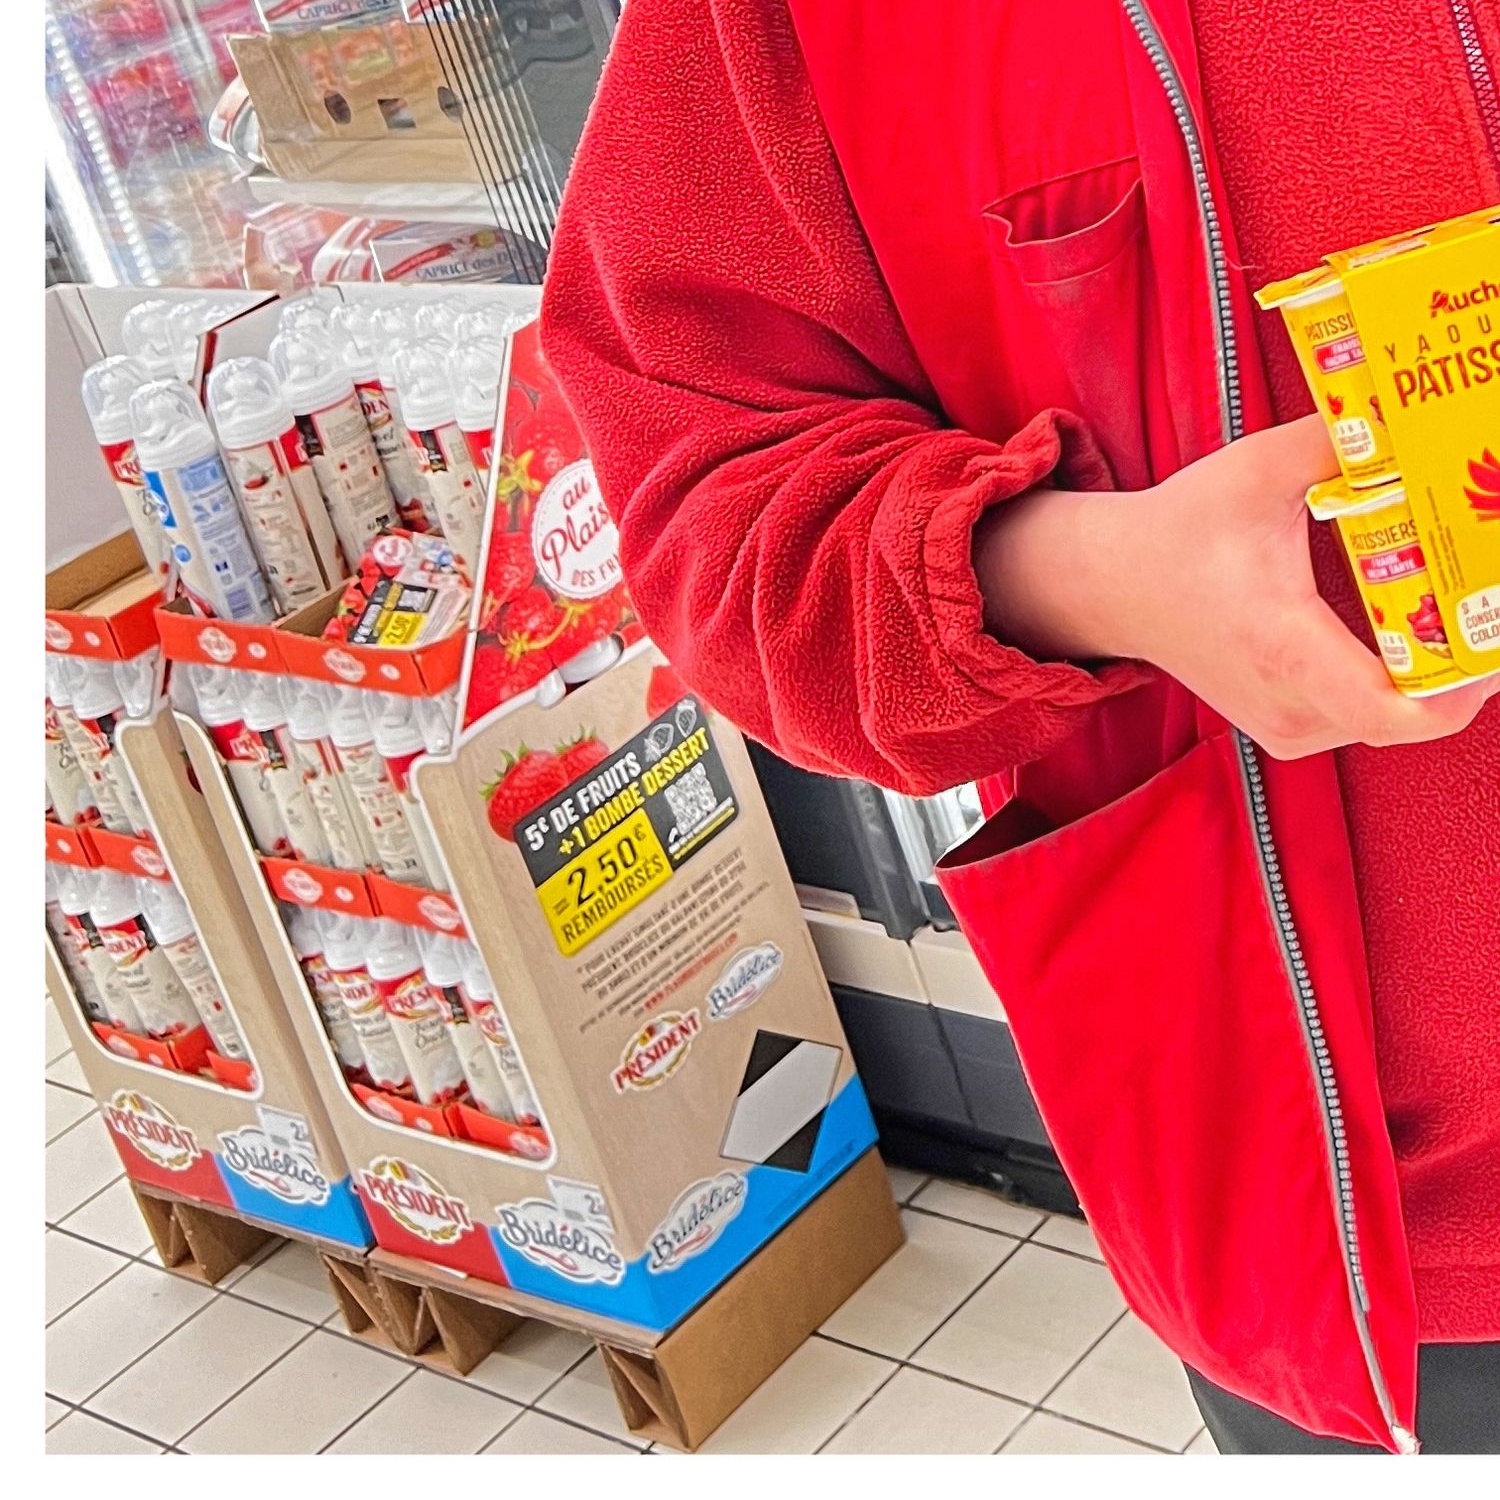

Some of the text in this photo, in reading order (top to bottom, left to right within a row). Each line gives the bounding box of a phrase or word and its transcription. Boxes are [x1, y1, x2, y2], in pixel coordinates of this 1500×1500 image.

[562, 476, 590, 511] au
[571, 566, 595, 586] DES
[550, 798, 580, 834] DE
[576, 751, 641, 814] FRUITS
[583, 781, 645, 841] BOMBE
[641, 727, 710, 796] DESSERT
[560, 852, 665, 943] REMBOURSÉS
[709, 942, 781, 1018] Bridélice
[614, 1014, 700, 1089] PRÉSIDENT
[108, 1106, 198, 1153] PRÉSIDENT
[222, 1137, 328, 1193] Bridélice
[364, 1174, 471, 1227] PRÉSIDENT
[650, 1175, 746, 1269] Bridélice
[502, 1206, 623, 1271] Bridélice
